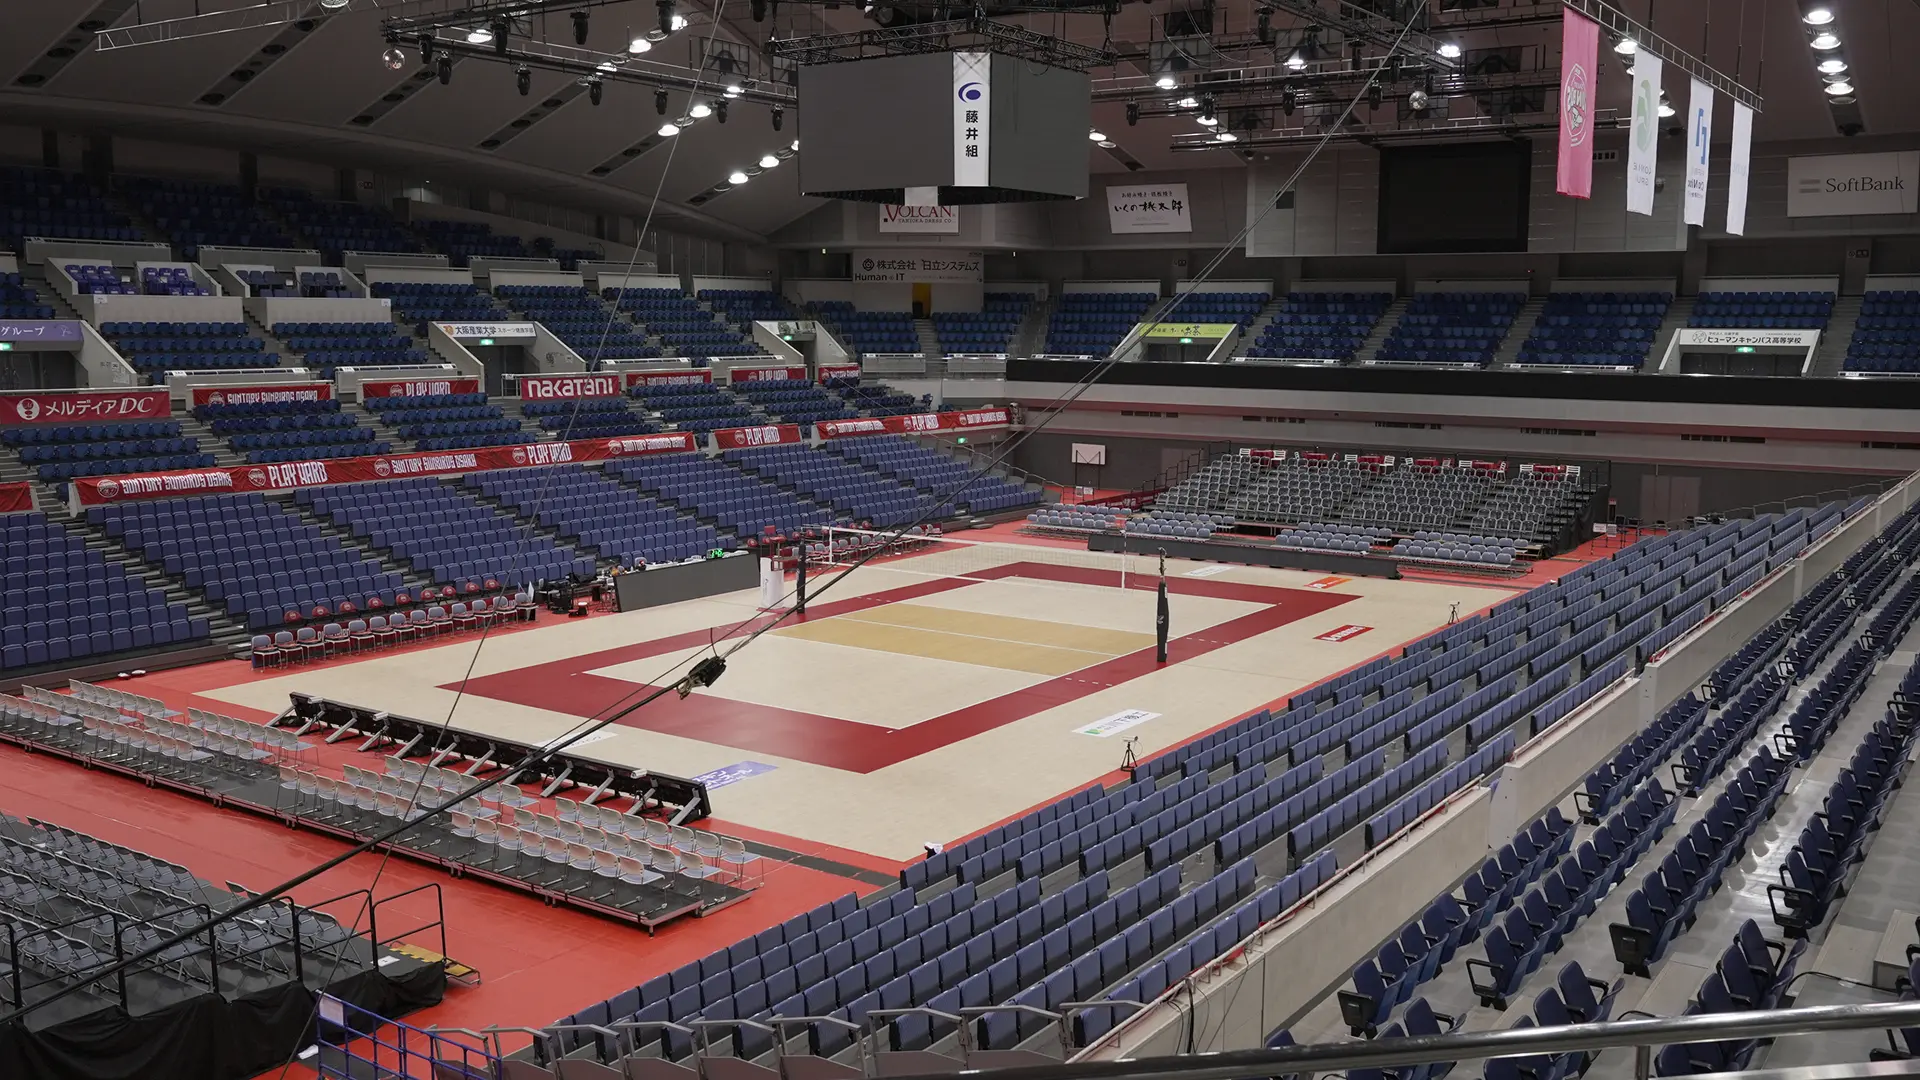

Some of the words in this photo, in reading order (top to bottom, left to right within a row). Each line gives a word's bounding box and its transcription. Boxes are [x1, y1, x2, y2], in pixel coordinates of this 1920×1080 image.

[965, 110, 979, 158] 藤井組
[1825, 176, 1905, 193] SoftBank
[885, 205, 952, 222] VOLCAN
[1114, 199, 1183, 216] いくの桃太郎
[876, 259, 917, 271] 株式会社
[922, 260, 980, 271] 日立システムズ
[855, 273, 888, 281] Human
[896, 273, 905, 281] IT
[0, 326, 46, 336] グループ
[455, 325, 497, 337] 大阪産業大学
[1707, 336, 1802, 344] ヒューマンキャンパス高等学校
[45, 396, 154, 417] メルディアDC
[745, 428, 763, 445] PLAY
[761, 426, 781, 444] HARD
[526, 444, 549, 465] PLAY
[548, 442, 573, 462] HARD
[391, 457, 422, 474] SUNTORY
[422, 455, 456, 471] SUNBIRDS
[454, 453, 478, 468] OSAKA
[267, 463, 297, 488] PLAY
[296, 461, 329, 484] HARD
[120, 476, 162, 494] SUNTORY
[162, 473, 206, 490] SUNBIRDS
